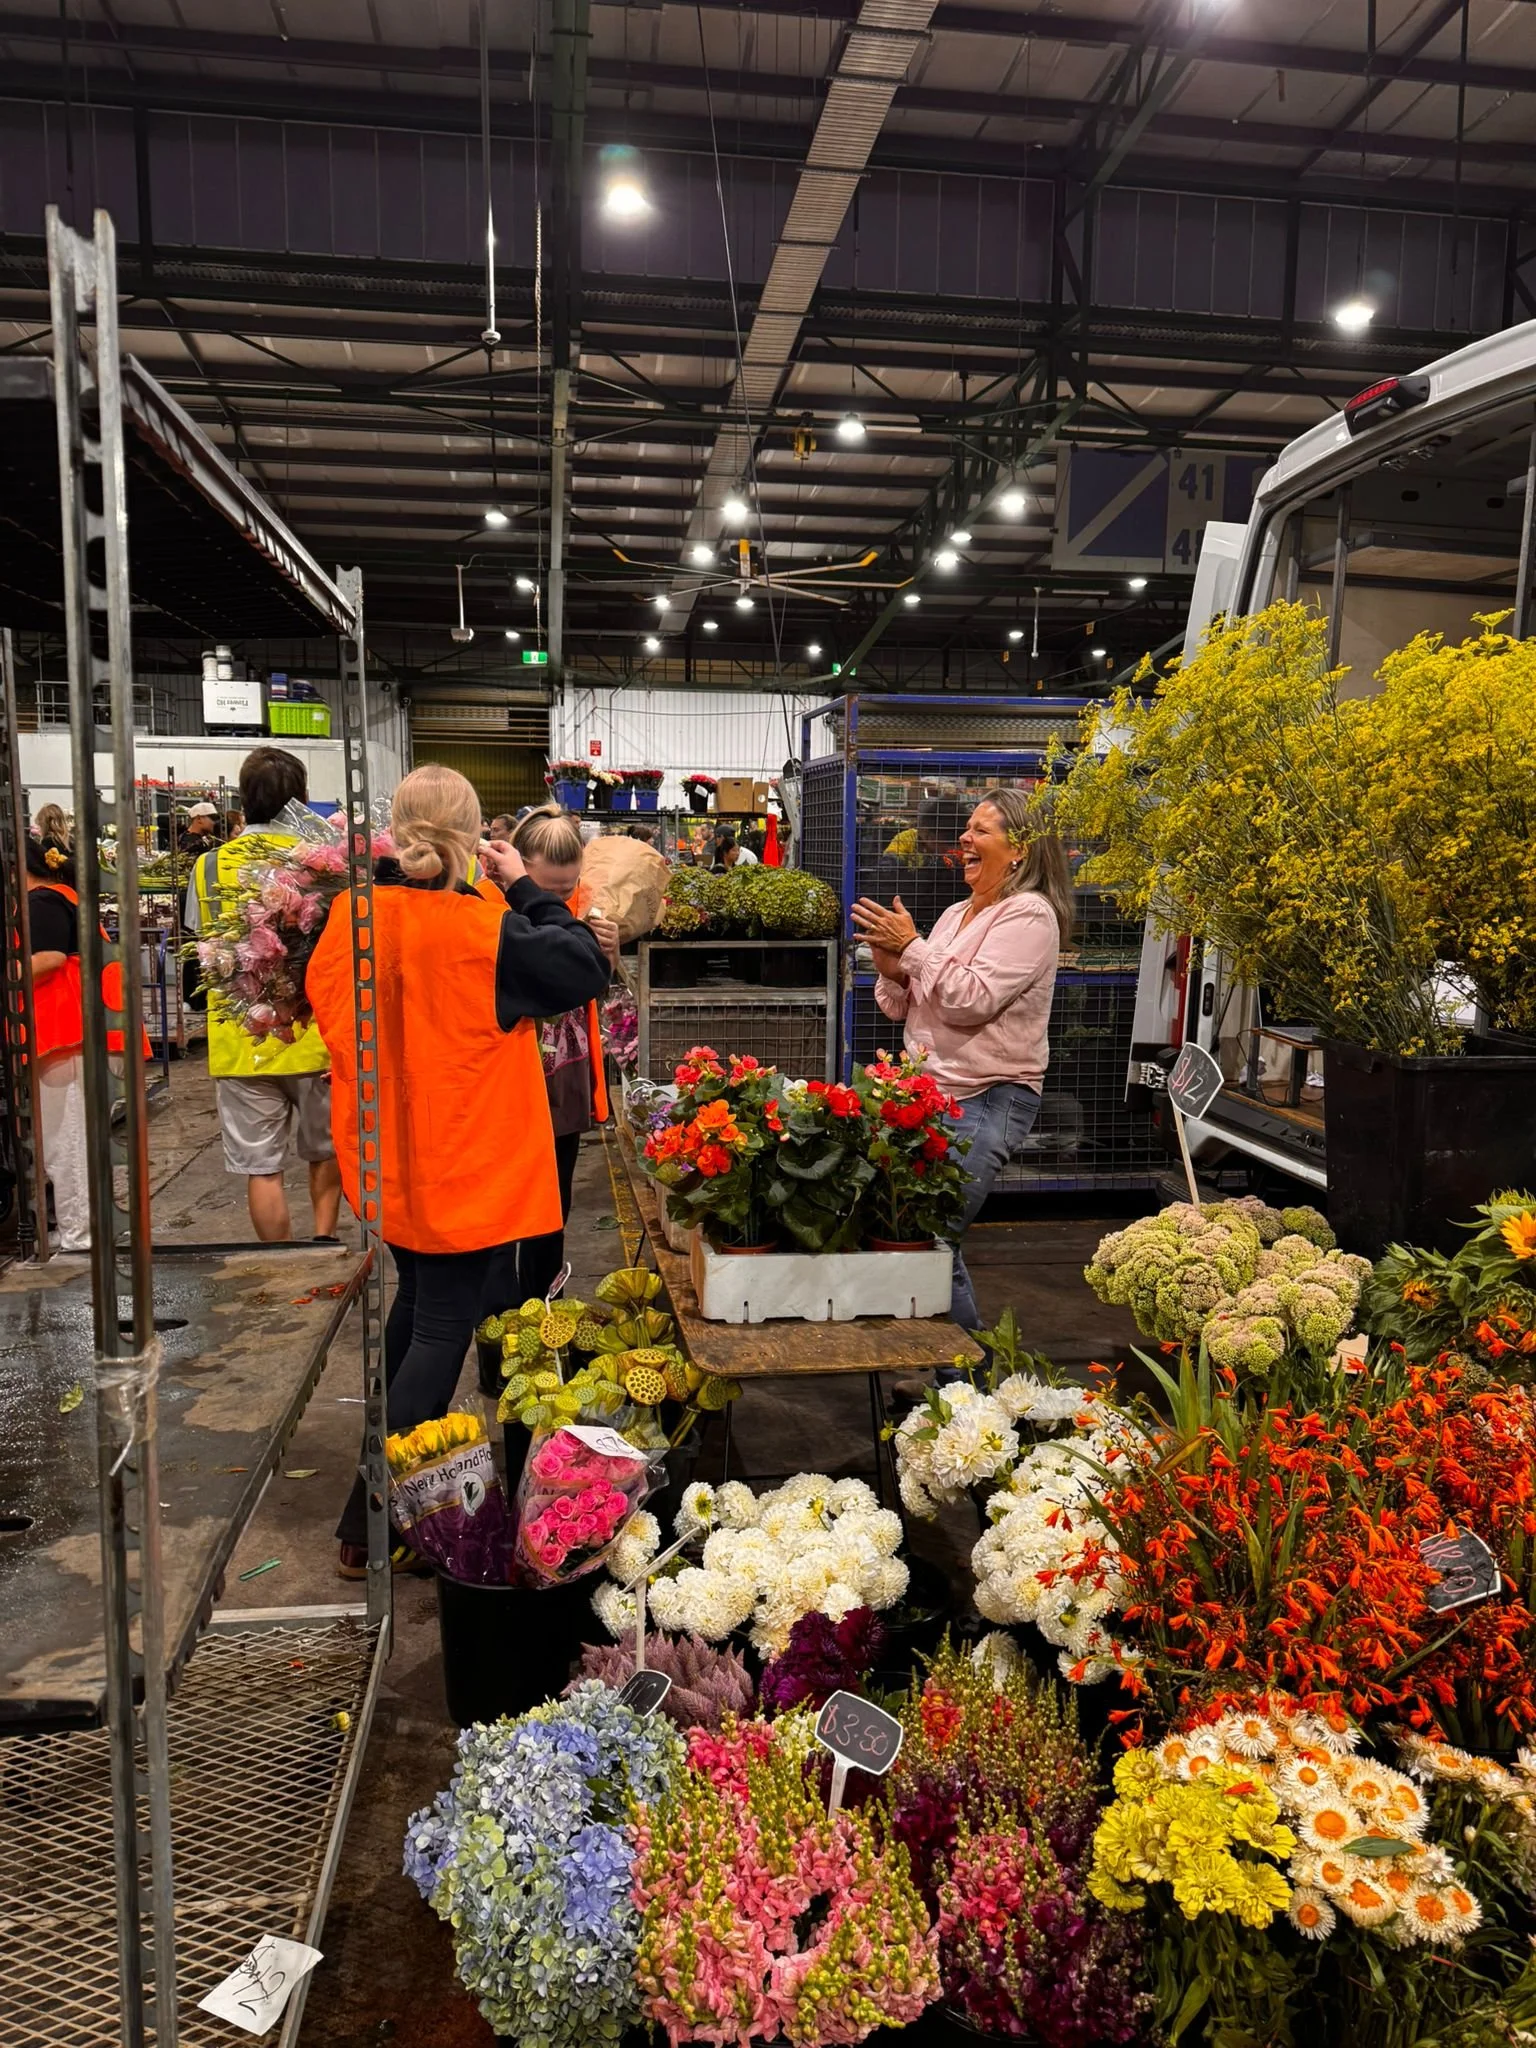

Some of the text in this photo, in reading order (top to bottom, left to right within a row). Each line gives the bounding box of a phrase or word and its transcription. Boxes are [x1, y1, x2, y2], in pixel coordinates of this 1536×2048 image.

[1178, 463, 1214, 501] 41
[1171, 1052, 1206, 1102] $12
[821, 1703, 889, 1756] $3.50
